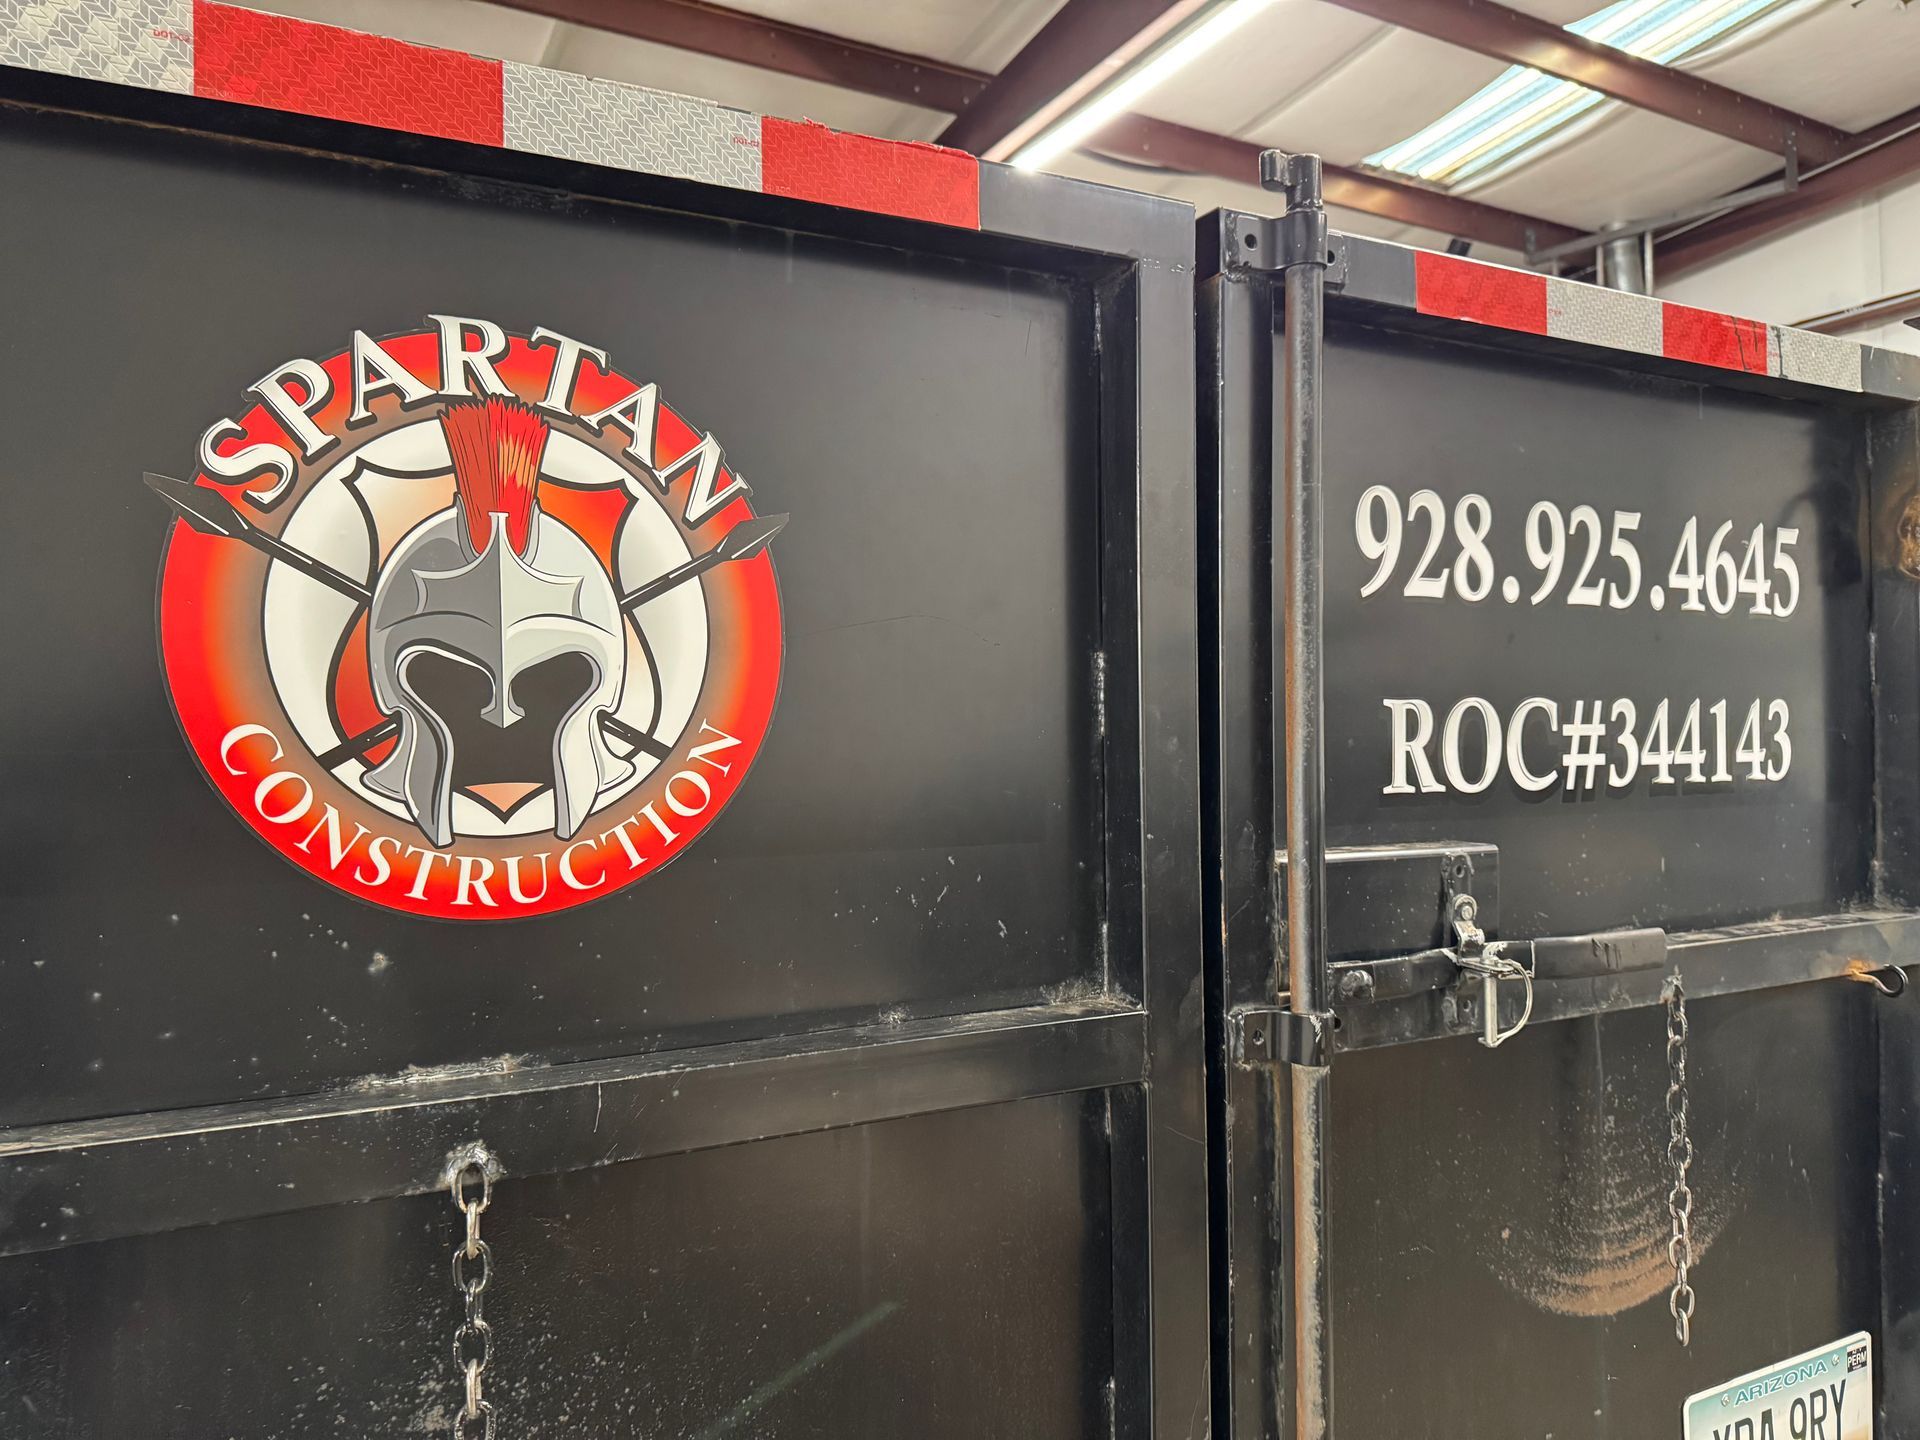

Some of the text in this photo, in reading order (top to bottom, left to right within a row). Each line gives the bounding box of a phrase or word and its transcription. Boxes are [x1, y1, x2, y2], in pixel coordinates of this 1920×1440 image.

[197, 313, 751, 526] SPARTAN
[1355, 484, 1800, 617] 928.925.4645
[1382, 696, 1792, 794] ROC#344143
[219, 718, 742, 907] CONSTRUCTION
[1734, 1360, 1827, 1406] ARIZONA
